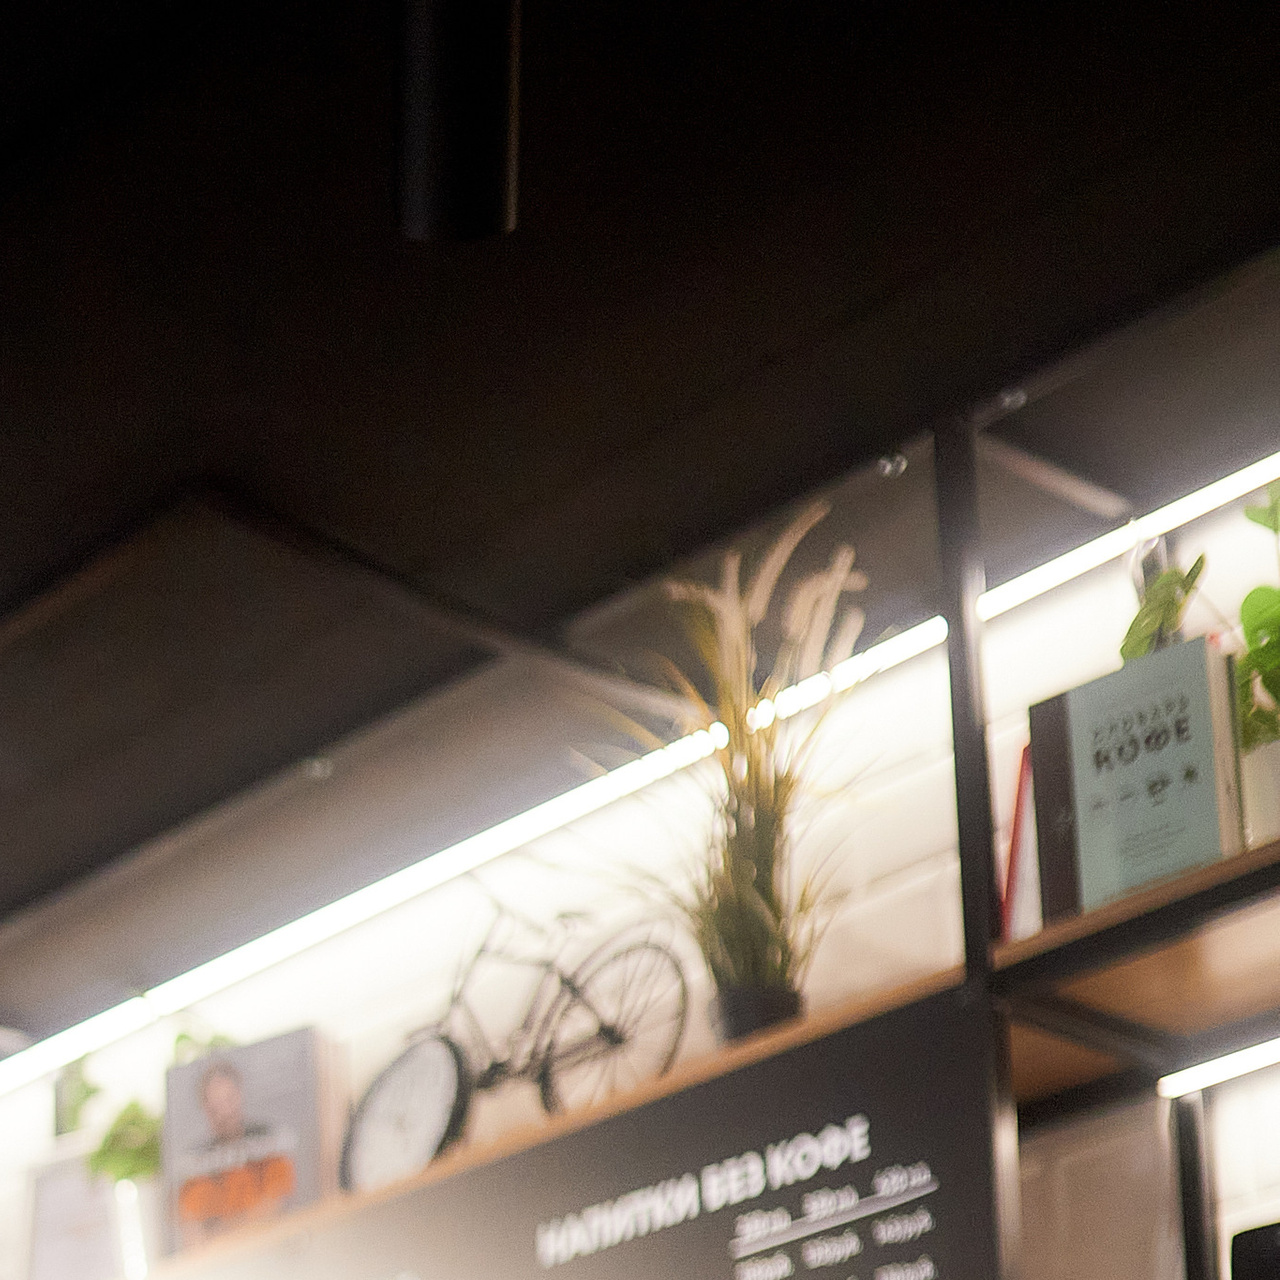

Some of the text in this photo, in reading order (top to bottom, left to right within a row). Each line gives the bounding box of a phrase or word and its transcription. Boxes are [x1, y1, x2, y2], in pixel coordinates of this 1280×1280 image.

[536, 1172, 701, 1267] НАПИТКИ
[700, 1151, 766, 1211] БЕЗ
[765, 1114, 870, 1190] КОФЕ
